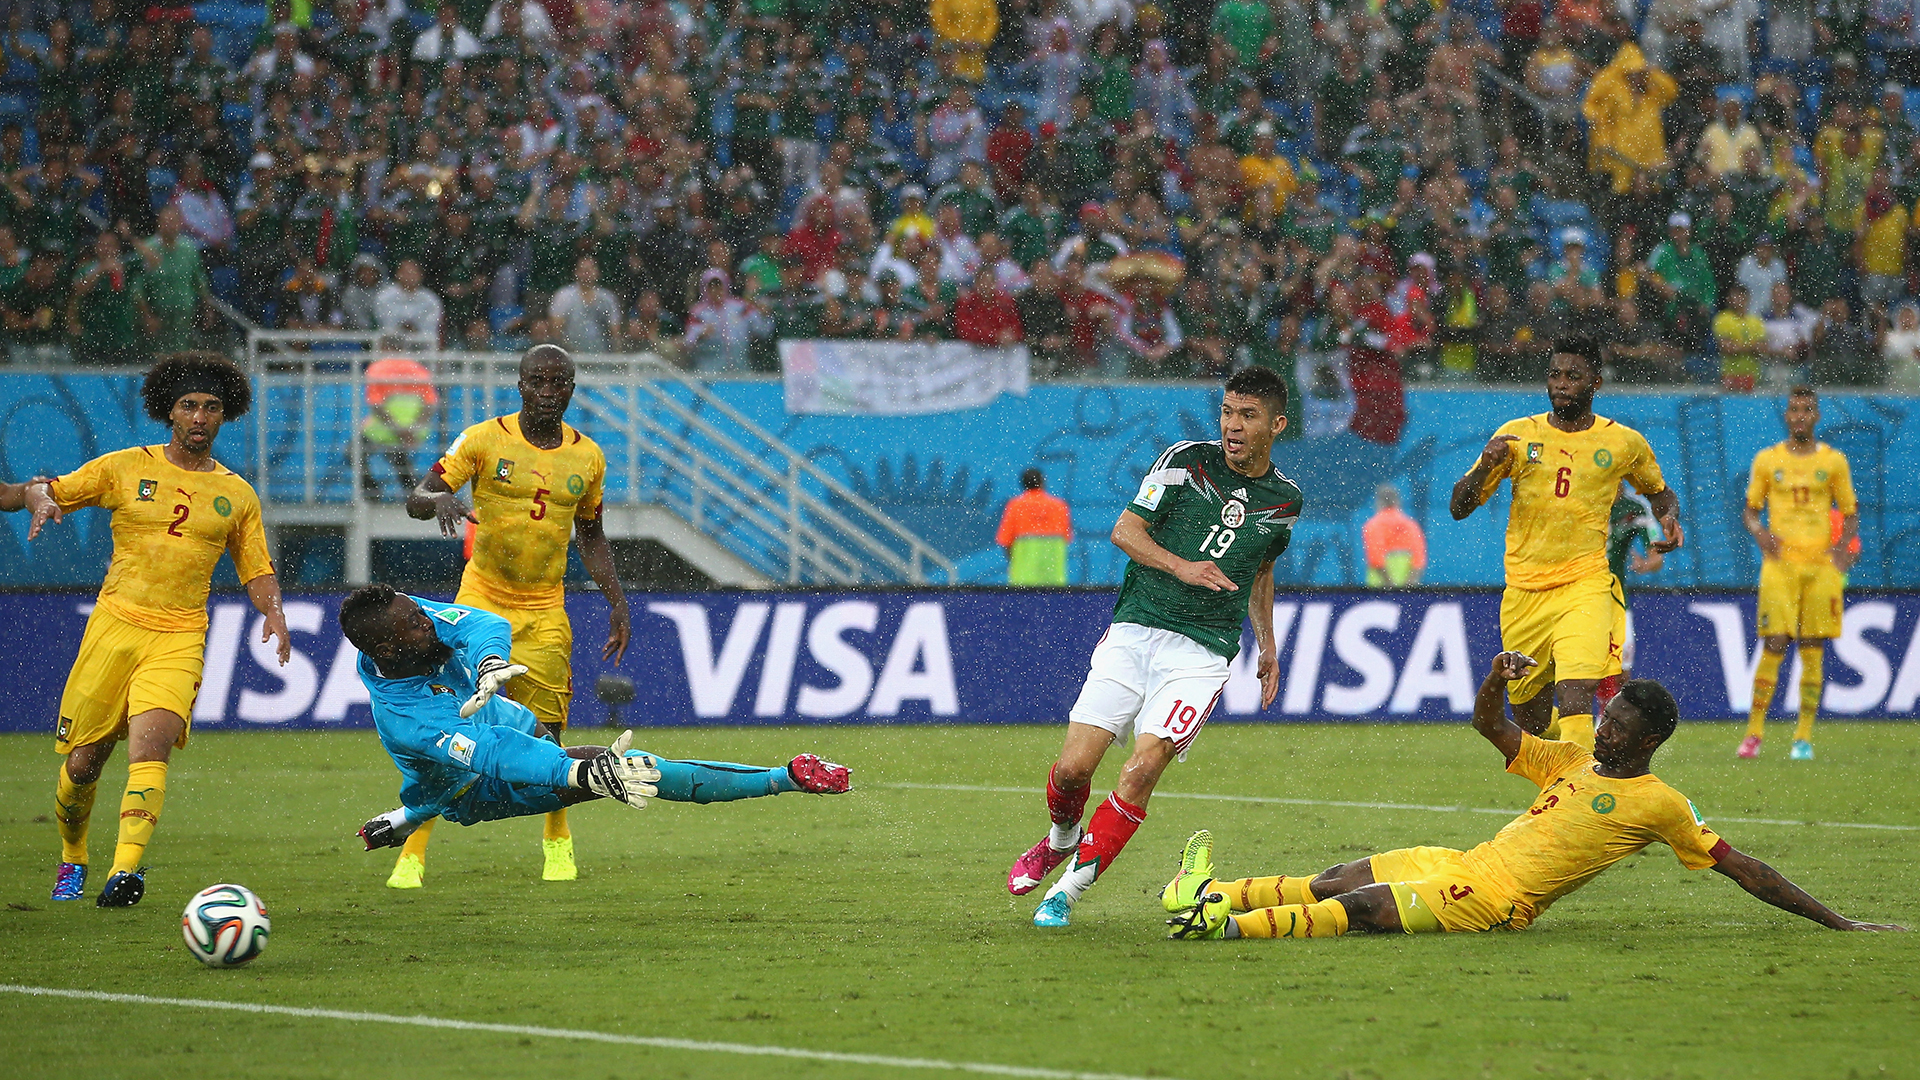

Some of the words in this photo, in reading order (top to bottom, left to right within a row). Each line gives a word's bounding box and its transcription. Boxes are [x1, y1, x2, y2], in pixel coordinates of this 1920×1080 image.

[1555, 466, 1572, 498] 6
[168, 504, 190, 538] 2
[530, 488, 550, 521] 5
[1198, 524, 1236, 558] 19
[648, 602, 960, 718] VISA
[1163, 699, 1197, 734] 19
